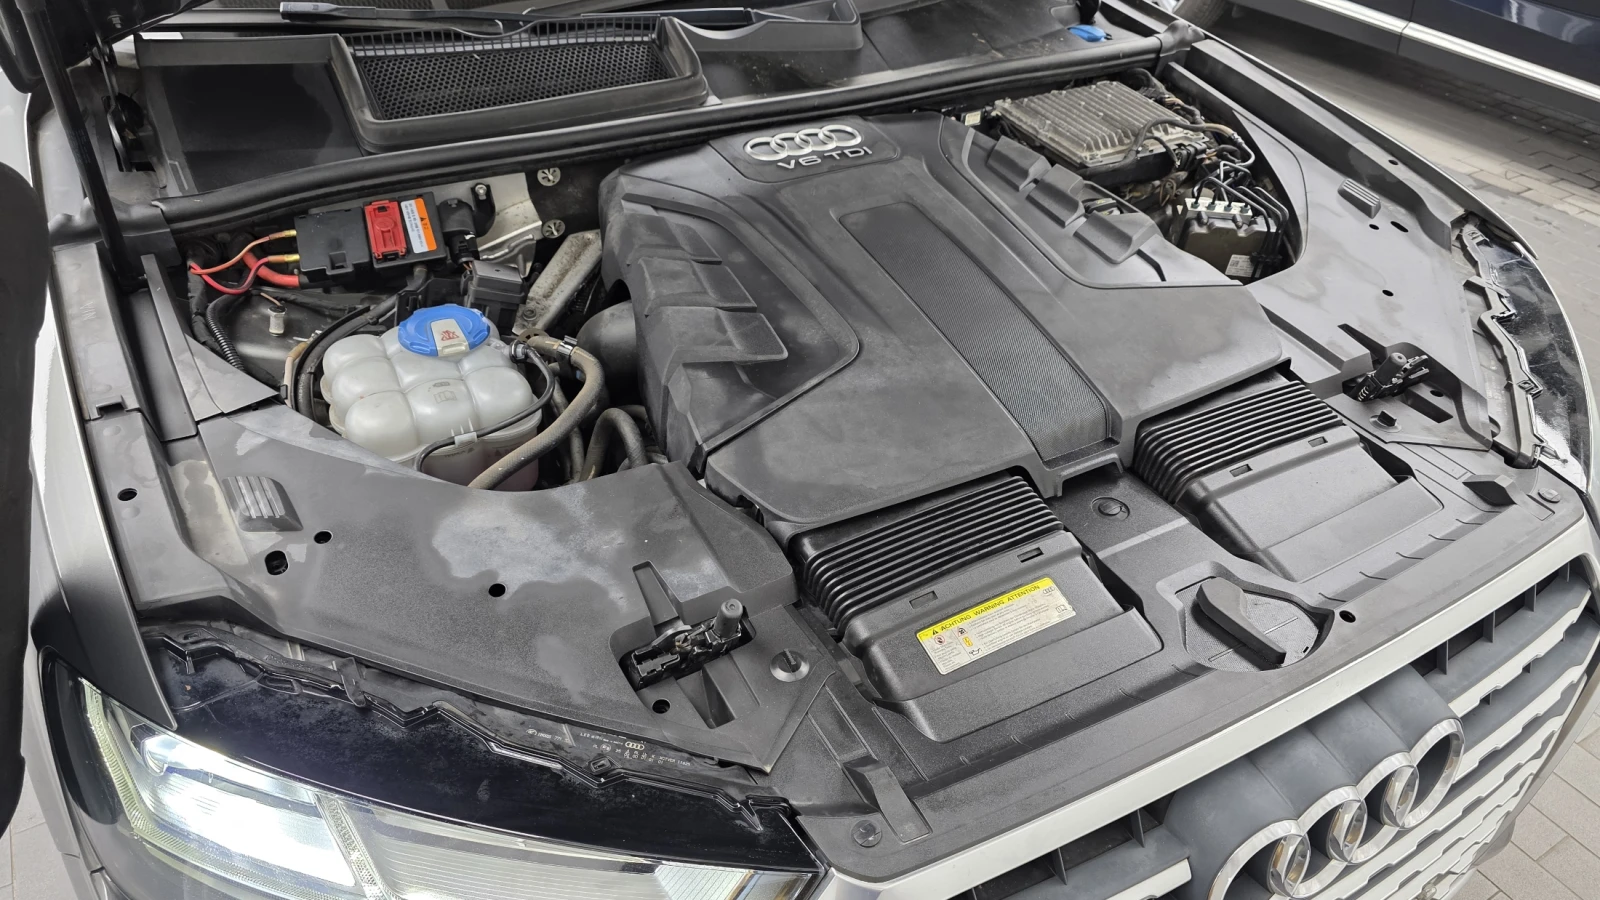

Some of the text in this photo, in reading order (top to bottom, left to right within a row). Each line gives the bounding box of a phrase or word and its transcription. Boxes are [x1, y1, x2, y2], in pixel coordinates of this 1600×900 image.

[777, 146, 873, 169] V6 TDI
[940, 584, 1041, 632] ACHTUNG WARNING ATTENTION
